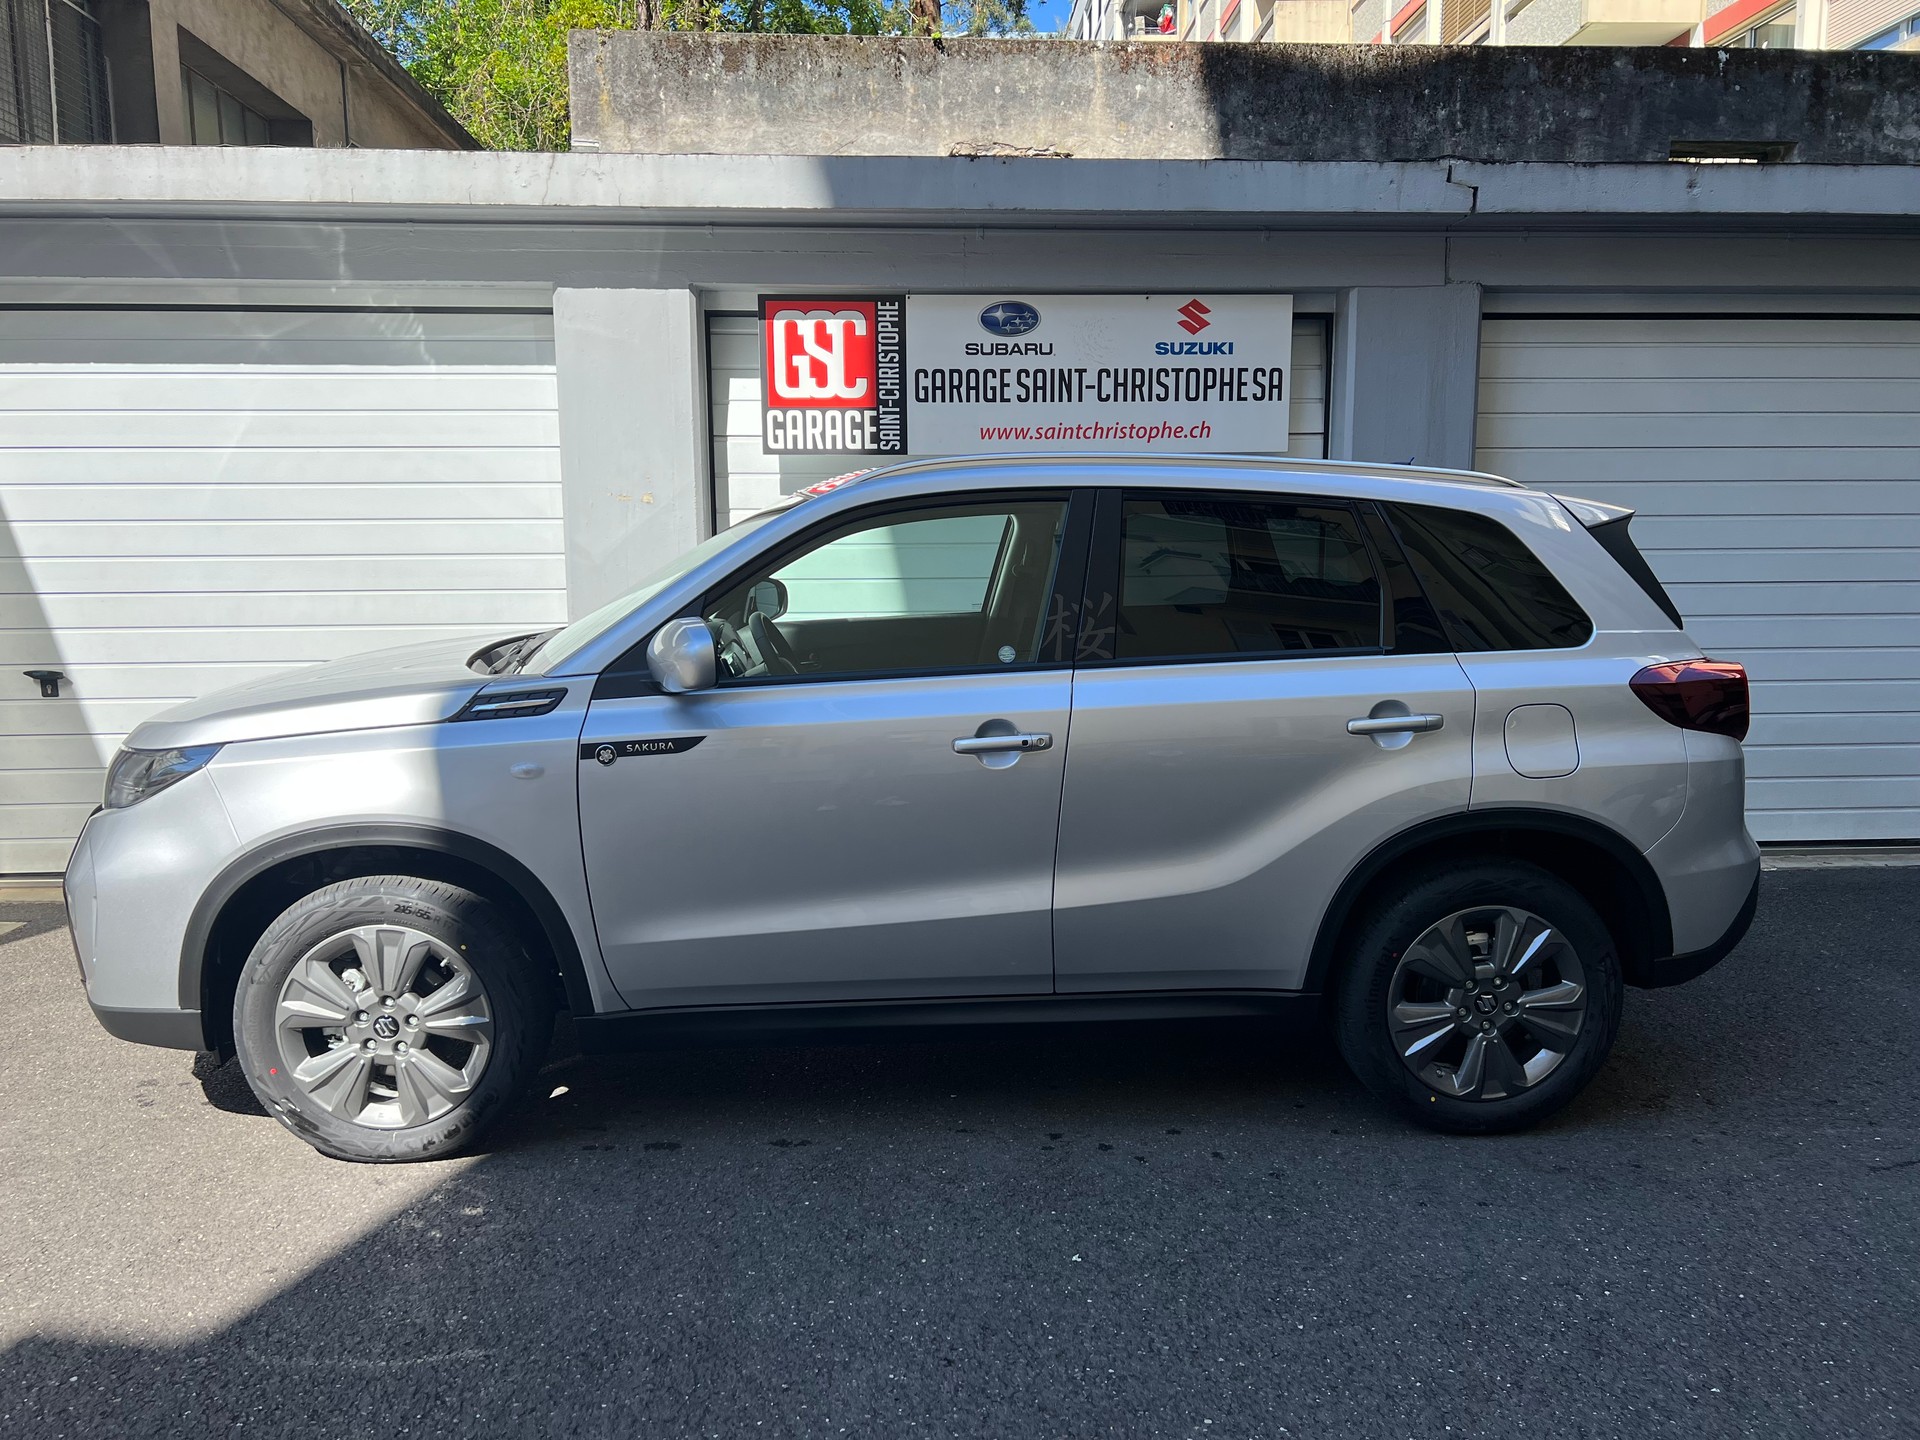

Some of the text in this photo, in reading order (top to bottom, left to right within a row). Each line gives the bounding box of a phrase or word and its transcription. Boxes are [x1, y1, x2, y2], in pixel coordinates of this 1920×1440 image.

[773, 309, 868, 399] GSC
[964, 342, 1054, 356] SUBARU
[1155, 341, 1234, 356] SUZUKI
[877, 301, 901, 451] SAINT-CHRISTOPHE
[914, 368, 1012, 403] GARAGE
[766, 409, 878, 450] GARAGE
[979, 420, 1212, 444] www.saintchristophe.ch
[1042, 591, 1117, 662] 桜
[626, 741, 675, 753] SAKURA
